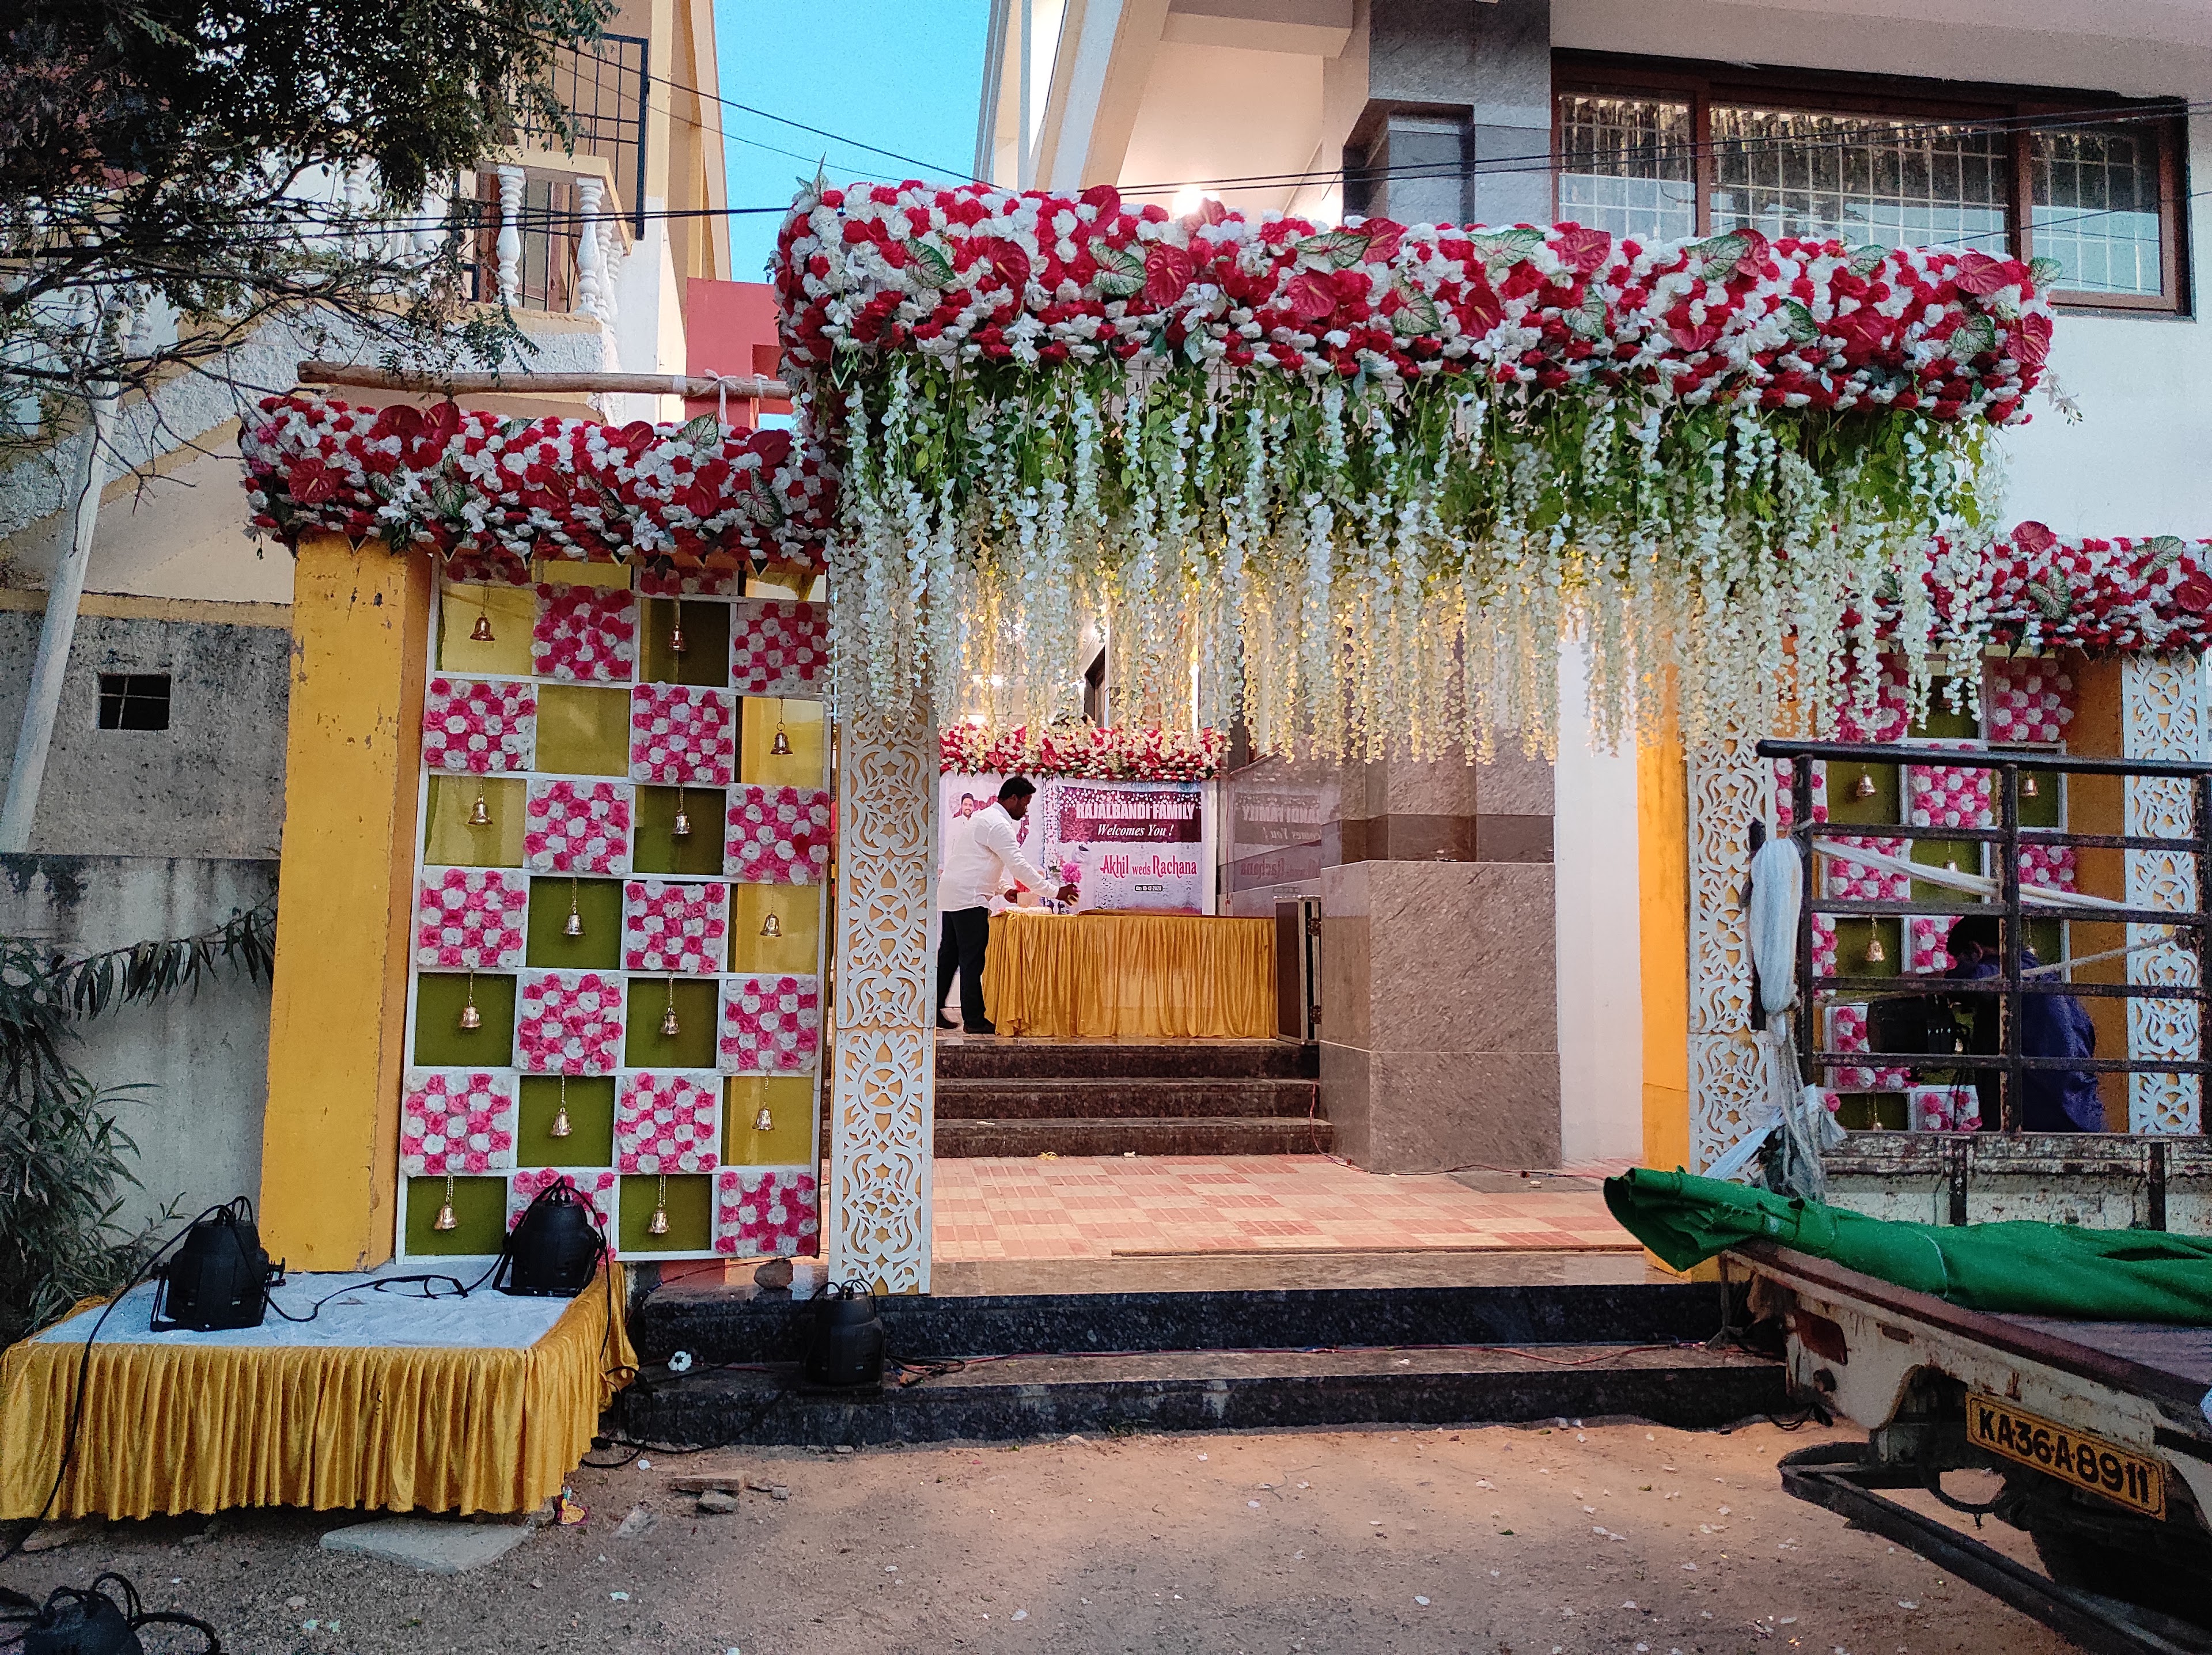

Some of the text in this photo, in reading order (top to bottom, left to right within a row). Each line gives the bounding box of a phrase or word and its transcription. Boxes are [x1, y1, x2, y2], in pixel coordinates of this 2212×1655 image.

[1075, 803, 1195, 820] RAJALBANDI FAMILY
[1097, 824, 1145, 836] Welcomes
[1148, 824, 1166, 836] You
[1100, 855, 1197, 878] Akhil weds Rachana
